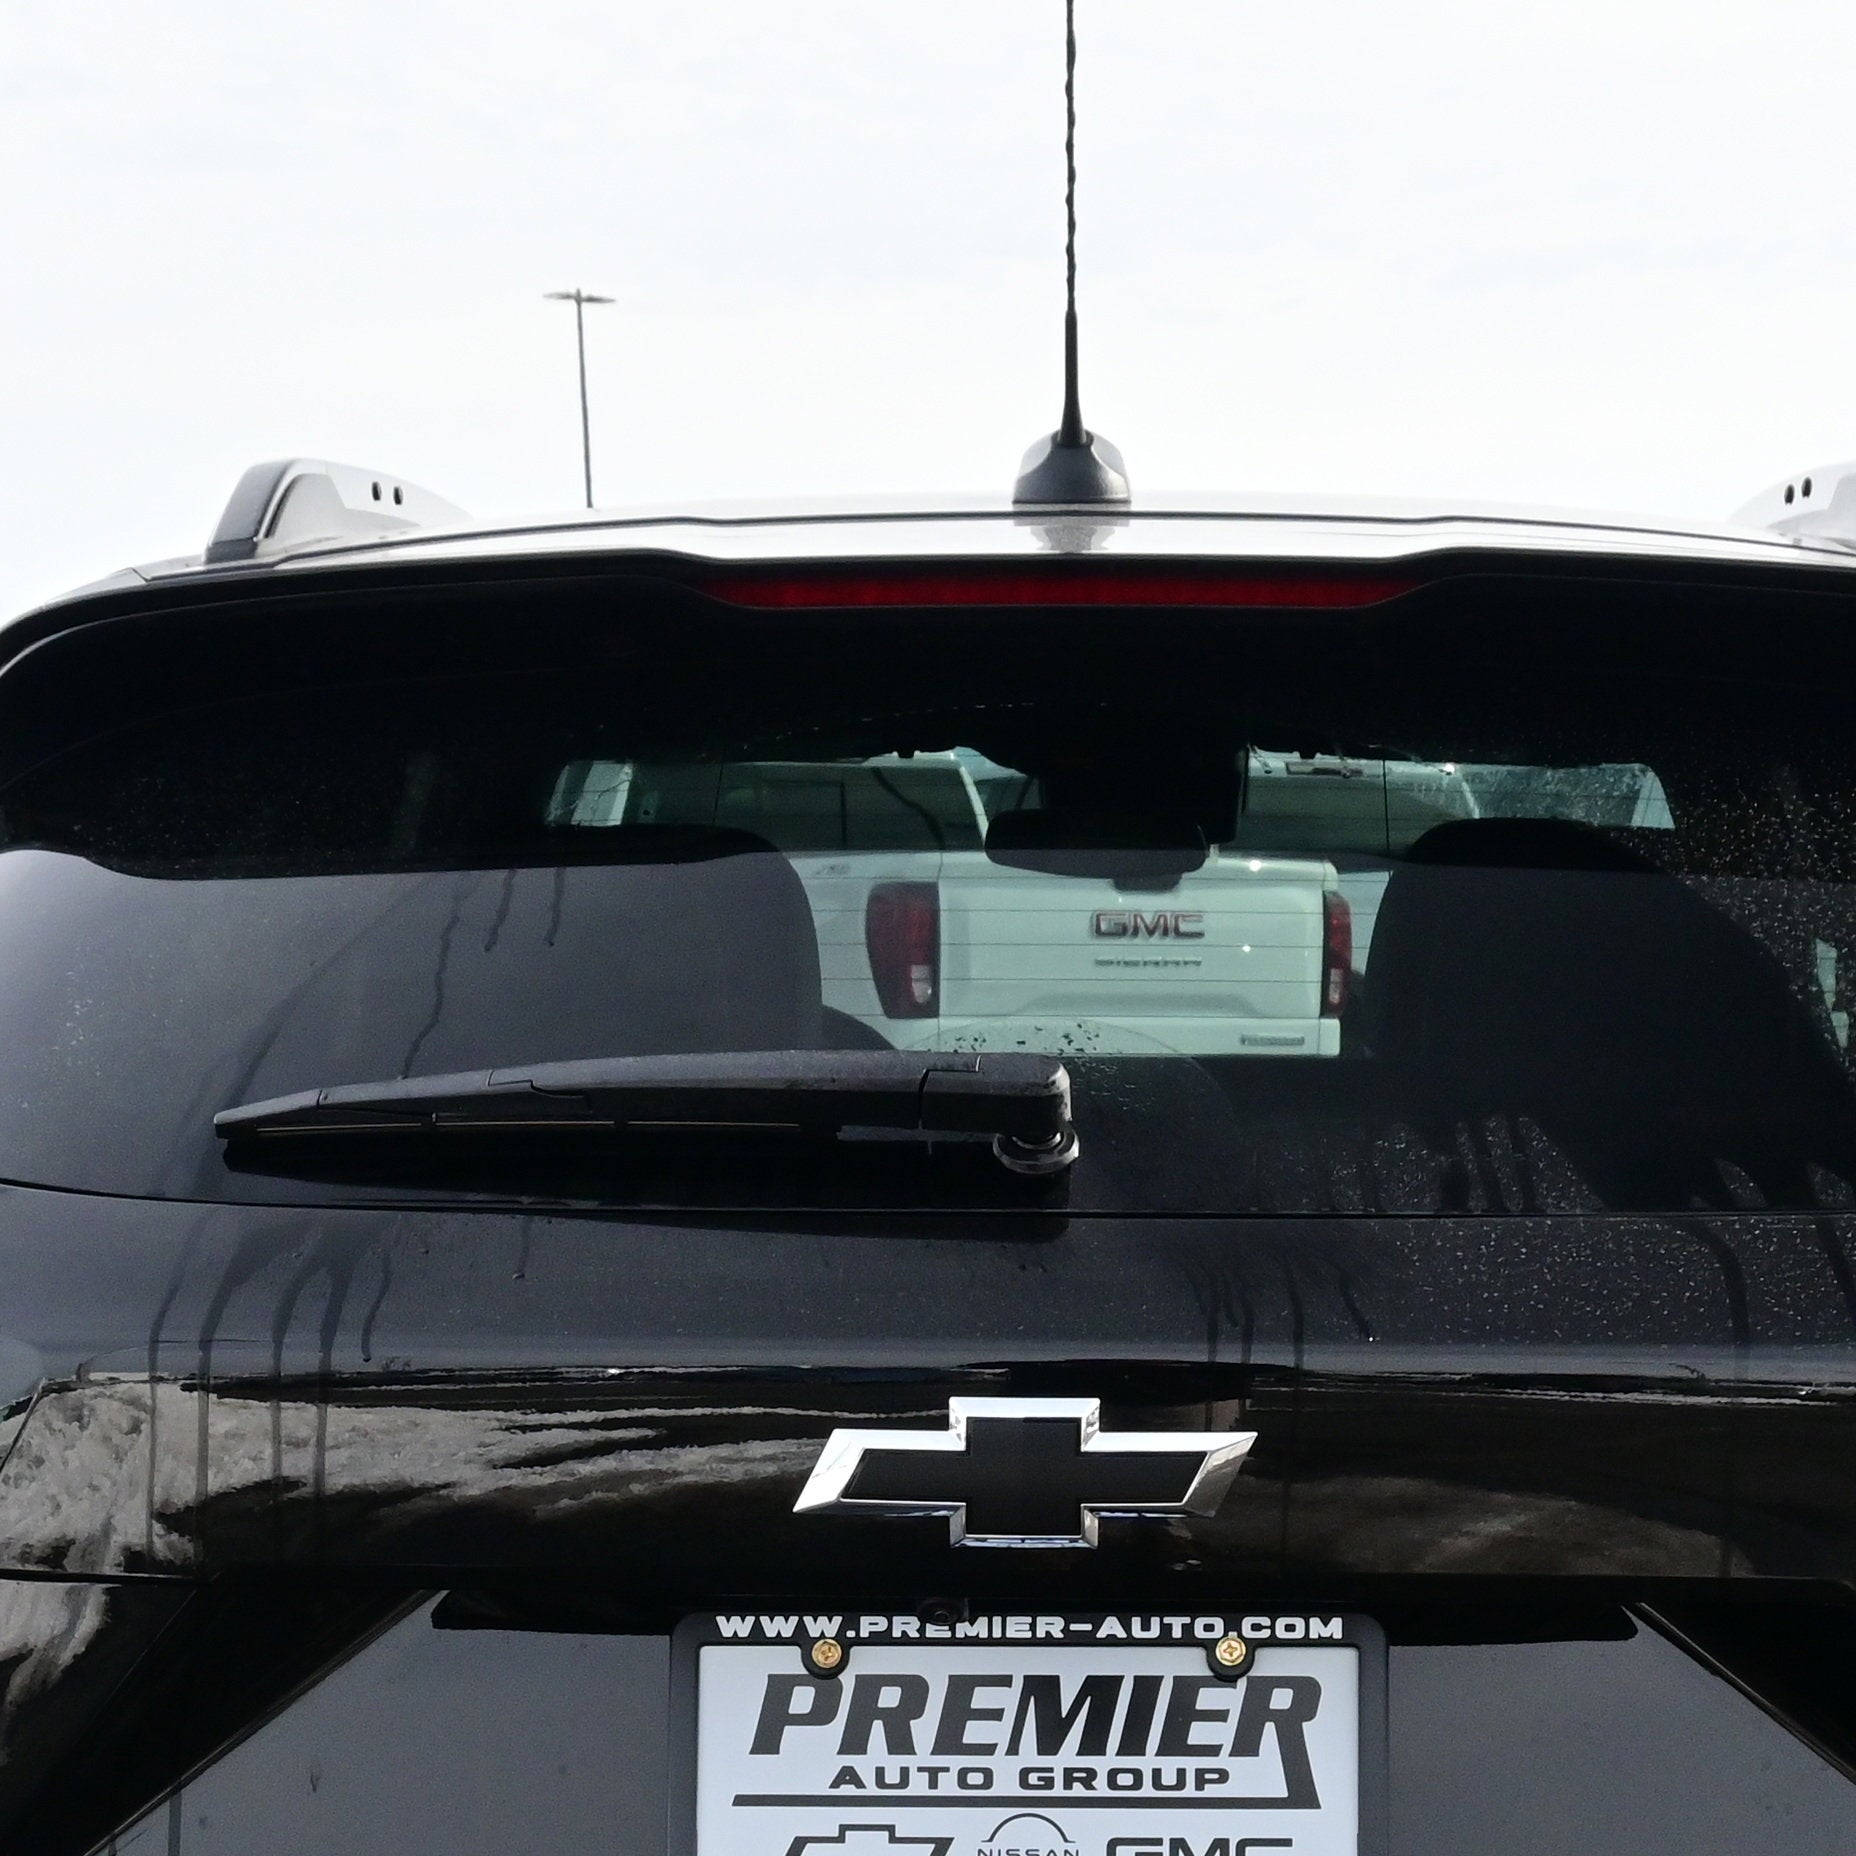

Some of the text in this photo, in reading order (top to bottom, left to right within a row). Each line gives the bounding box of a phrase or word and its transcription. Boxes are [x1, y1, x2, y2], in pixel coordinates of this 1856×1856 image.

[1093, 910, 1206, 938] GMC
[715, 1616, 1343, 1639] WWW.PREMIER-AUTO.COM
[748, 1673, 1323, 1809] PREMIER
[828, 1765, 1230, 1792] AUTO GROUP
